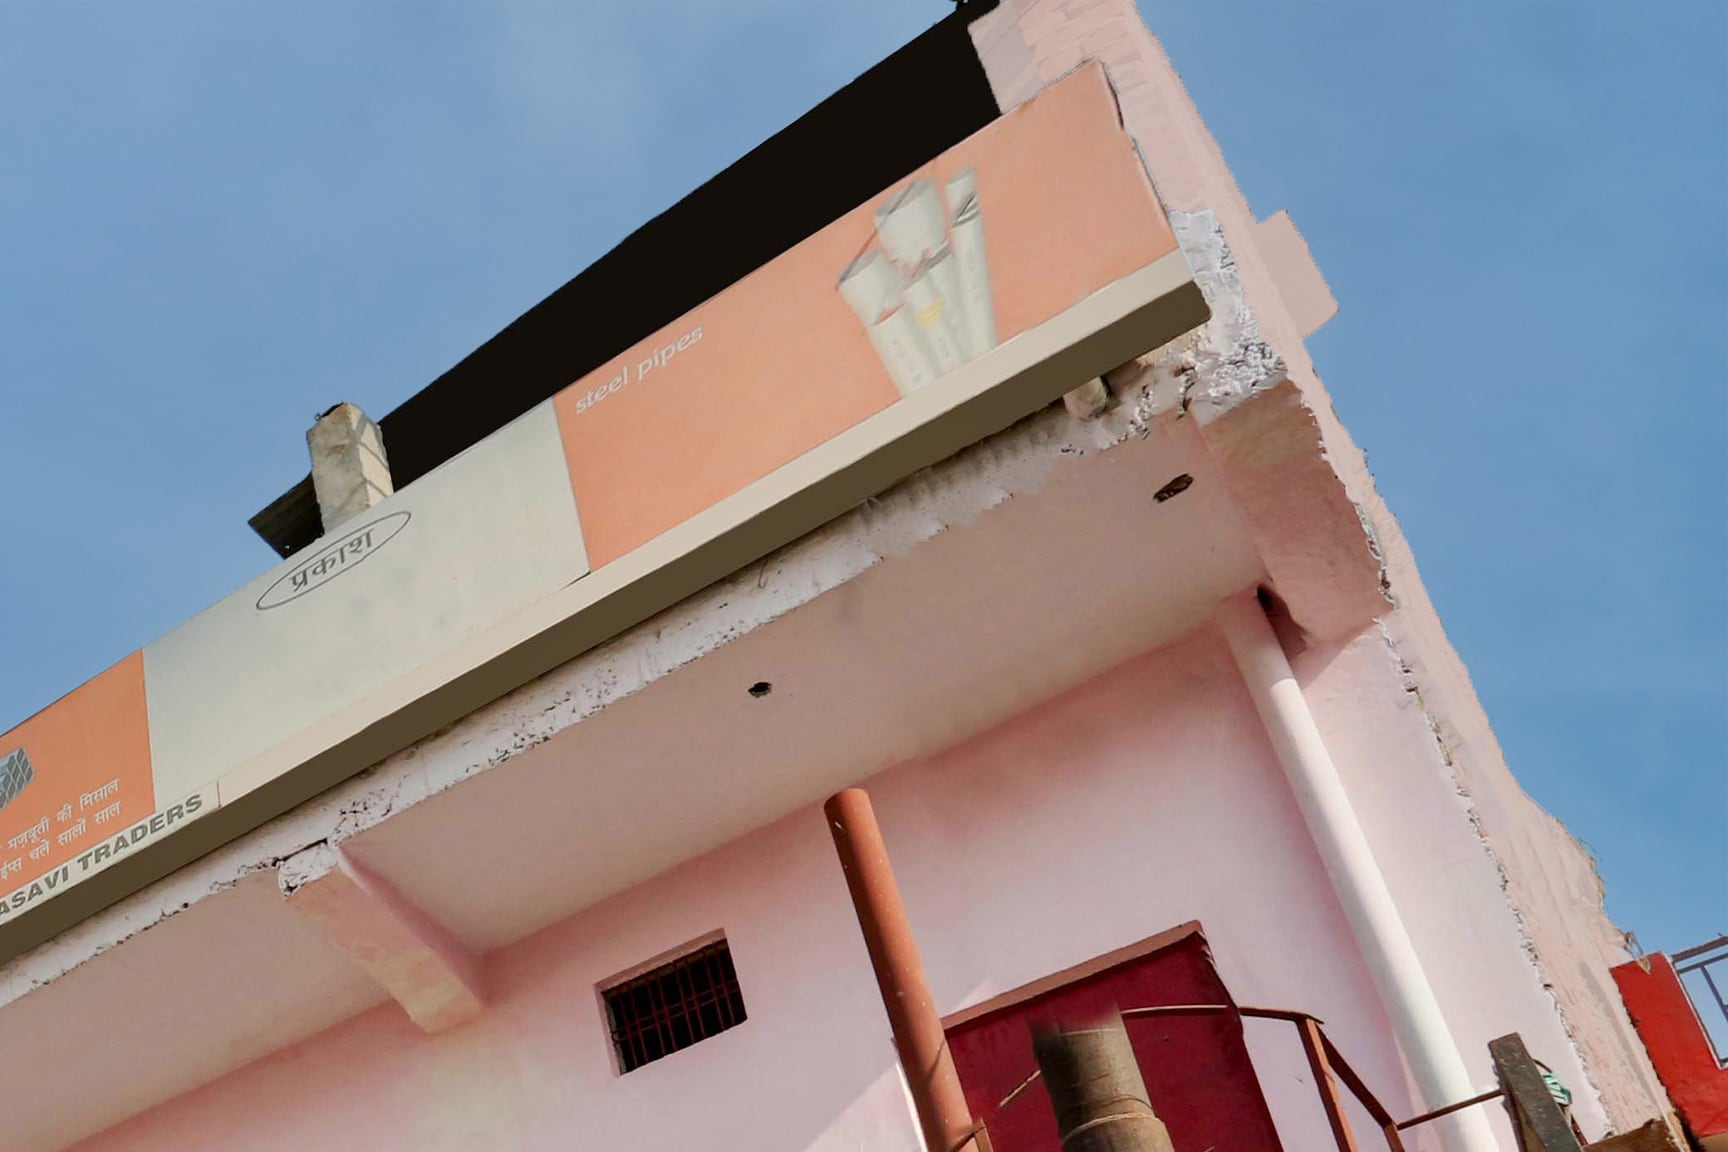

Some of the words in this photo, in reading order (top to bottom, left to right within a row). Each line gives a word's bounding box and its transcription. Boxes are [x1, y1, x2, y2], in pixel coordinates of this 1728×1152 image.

[575, 367, 629, 415] steel
[637, 325, 704, 382] pipes
[289, 528, 374, 593] प्रकाश
[56, 802, 73, 824] की
[79, 778, 120, 812] मिसाल
[77, 793, 204, 872] TRADERS
[93, 800, 121, 826] साल
